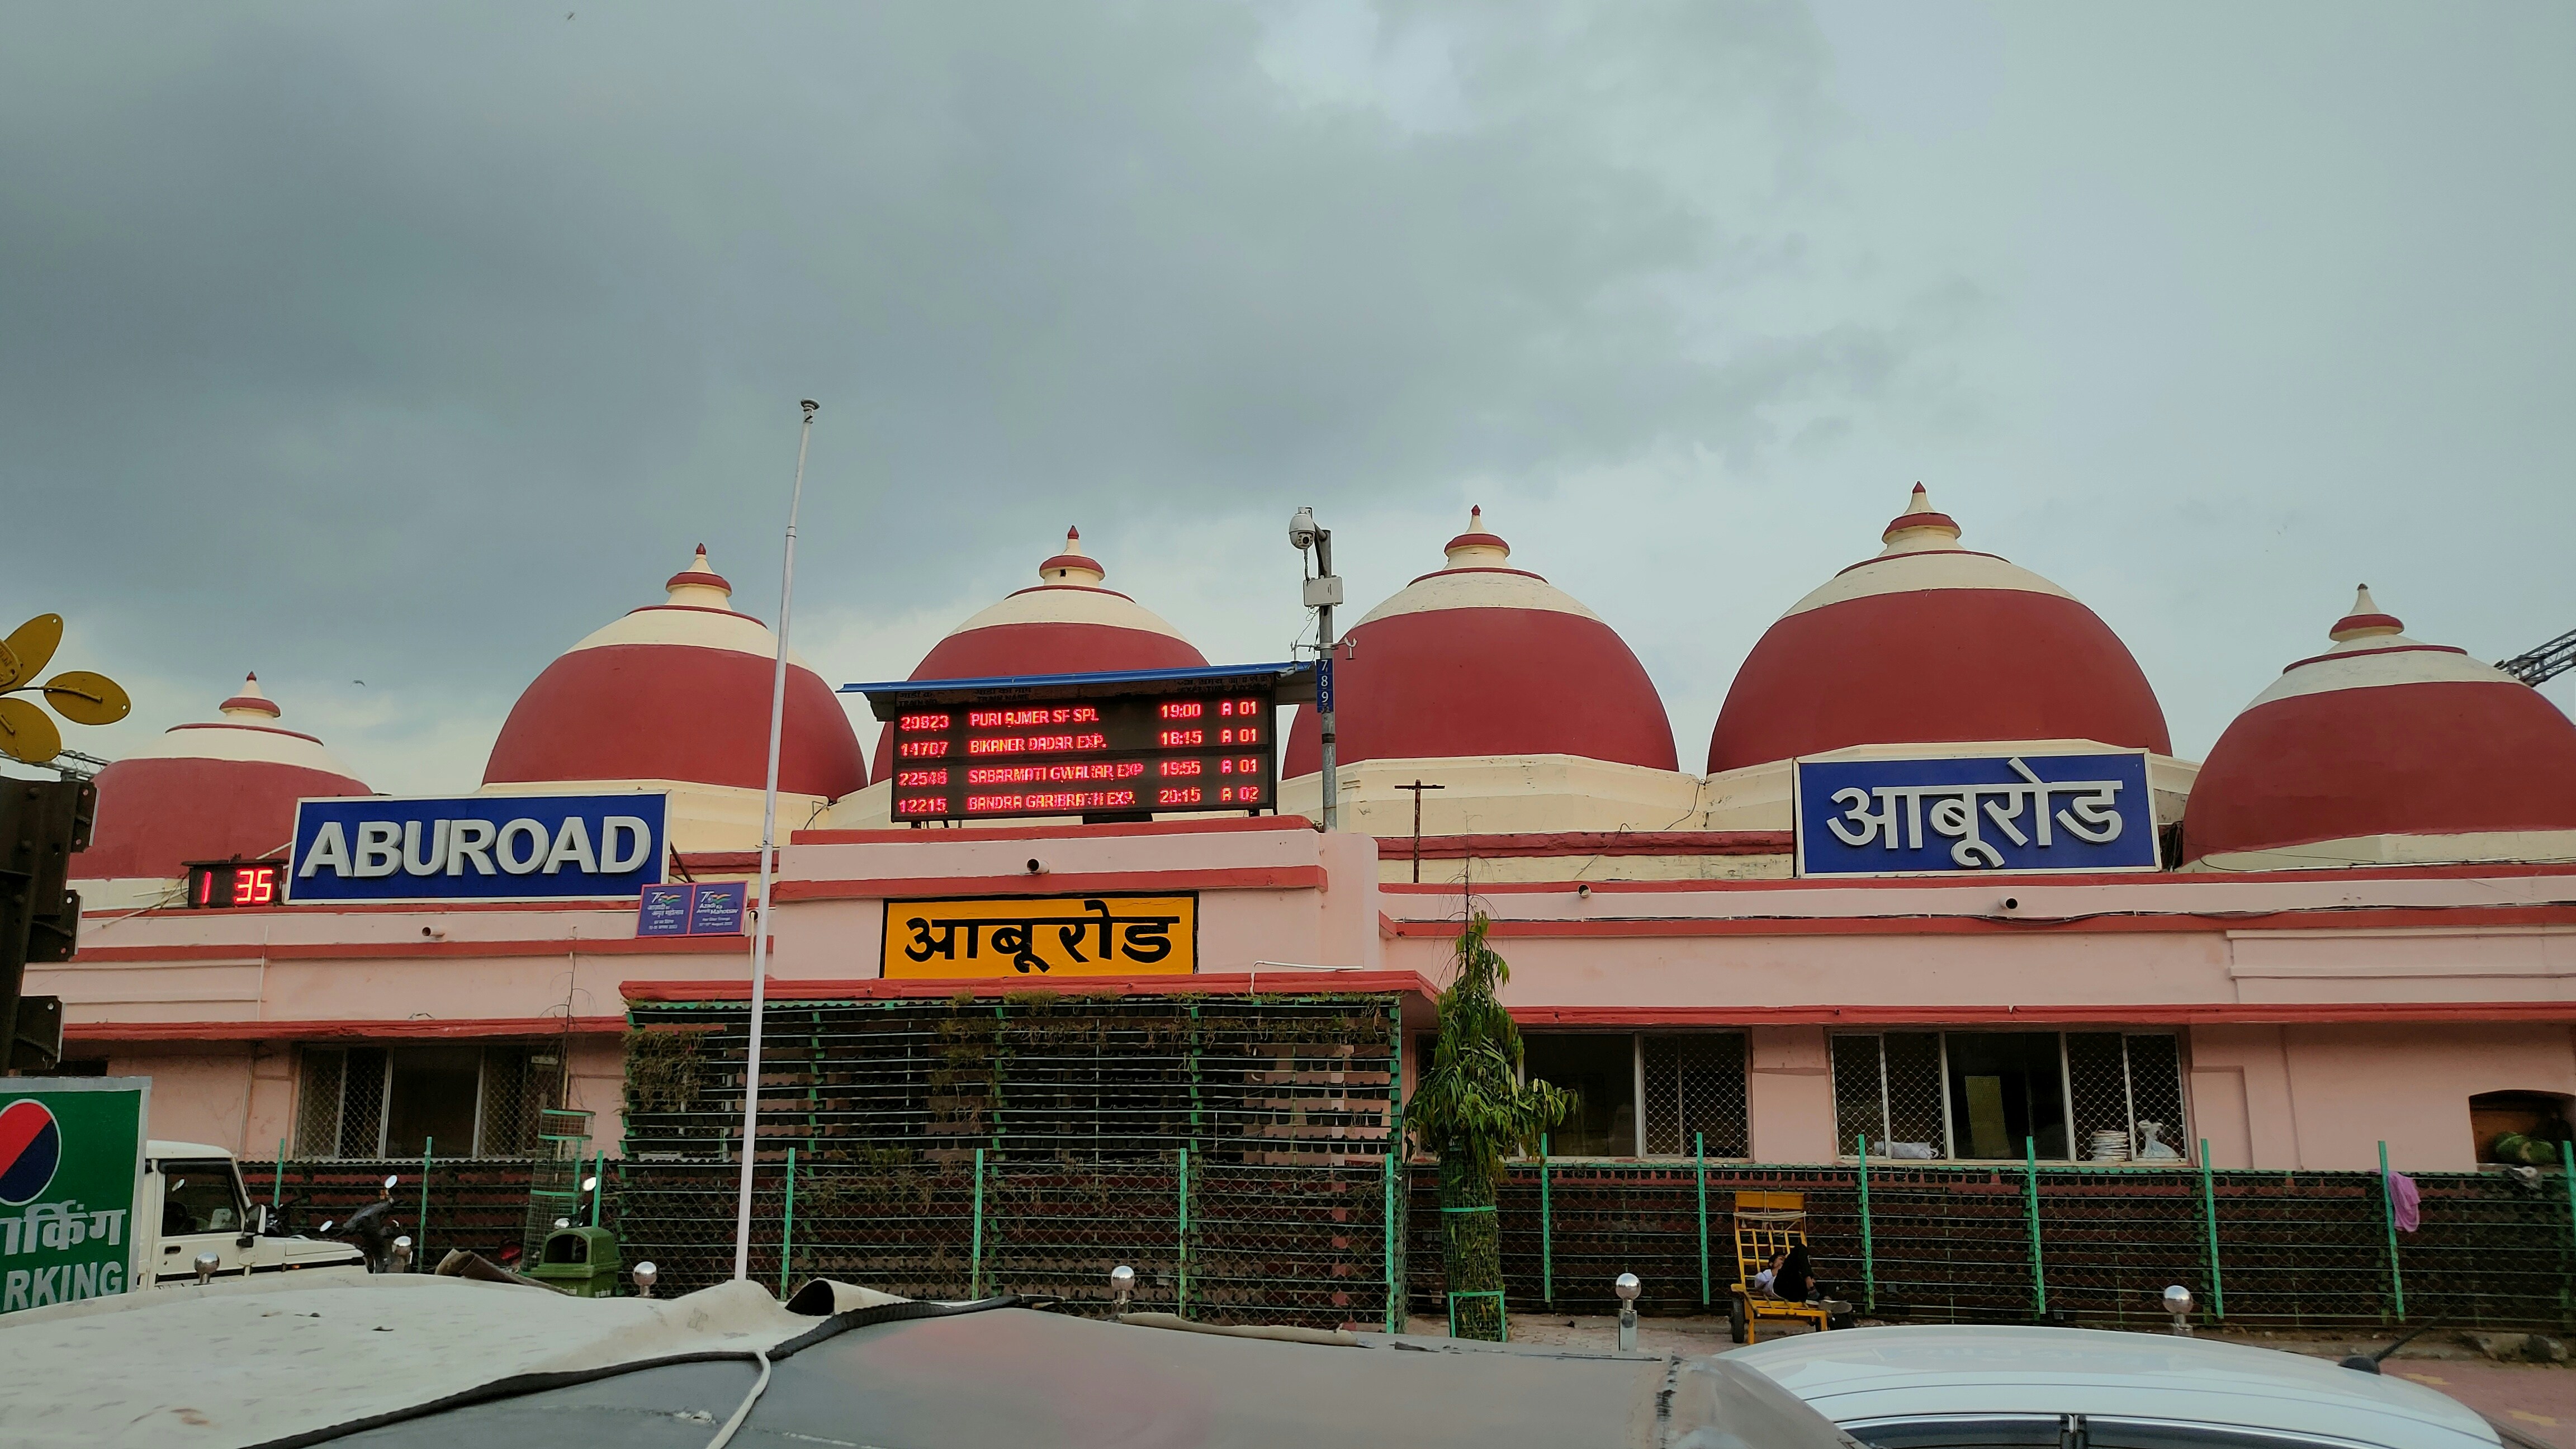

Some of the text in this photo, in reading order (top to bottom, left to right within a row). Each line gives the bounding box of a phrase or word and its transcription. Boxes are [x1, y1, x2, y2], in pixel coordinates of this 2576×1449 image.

[1321, 660, 1328, 671] 7
[1321, 675, 1328, 686] 8
[1321, 691, 1329, 703] 9
[970, 712, 1001, 727] PURI
[1005, 710, 1049, 726] AJMER
[1052, 708, 1070, 723] SF
[1073, 708, 1100, 722] SPL
[1161, 703, 1201, 718] 19:00
[1221, 702, 1233, 716] A
[1239, 701, 1257, 714] 01
[970, 738, 1025, 754] BIKANER
[1028, 736, 1073, 750] DADAR
[1221, 729, 1233, 743] A
[1239, 728, 1257, 742] 01
[968, 766, 1046, 783] SABARMATI
[1160, 761, 1201, 776] 19:55
[1221, 759, 1233, 773] A
[1239, 758, 1257, 773] 01
[968, 795, 1023, 811] BANDRA
[1159, 787, 1201, 803] 20:15
[1238, 786, 1259, 802] 02
[297, 816, 652, 878] ABUROAD
[3, 1261, 122, 1311] RKING
